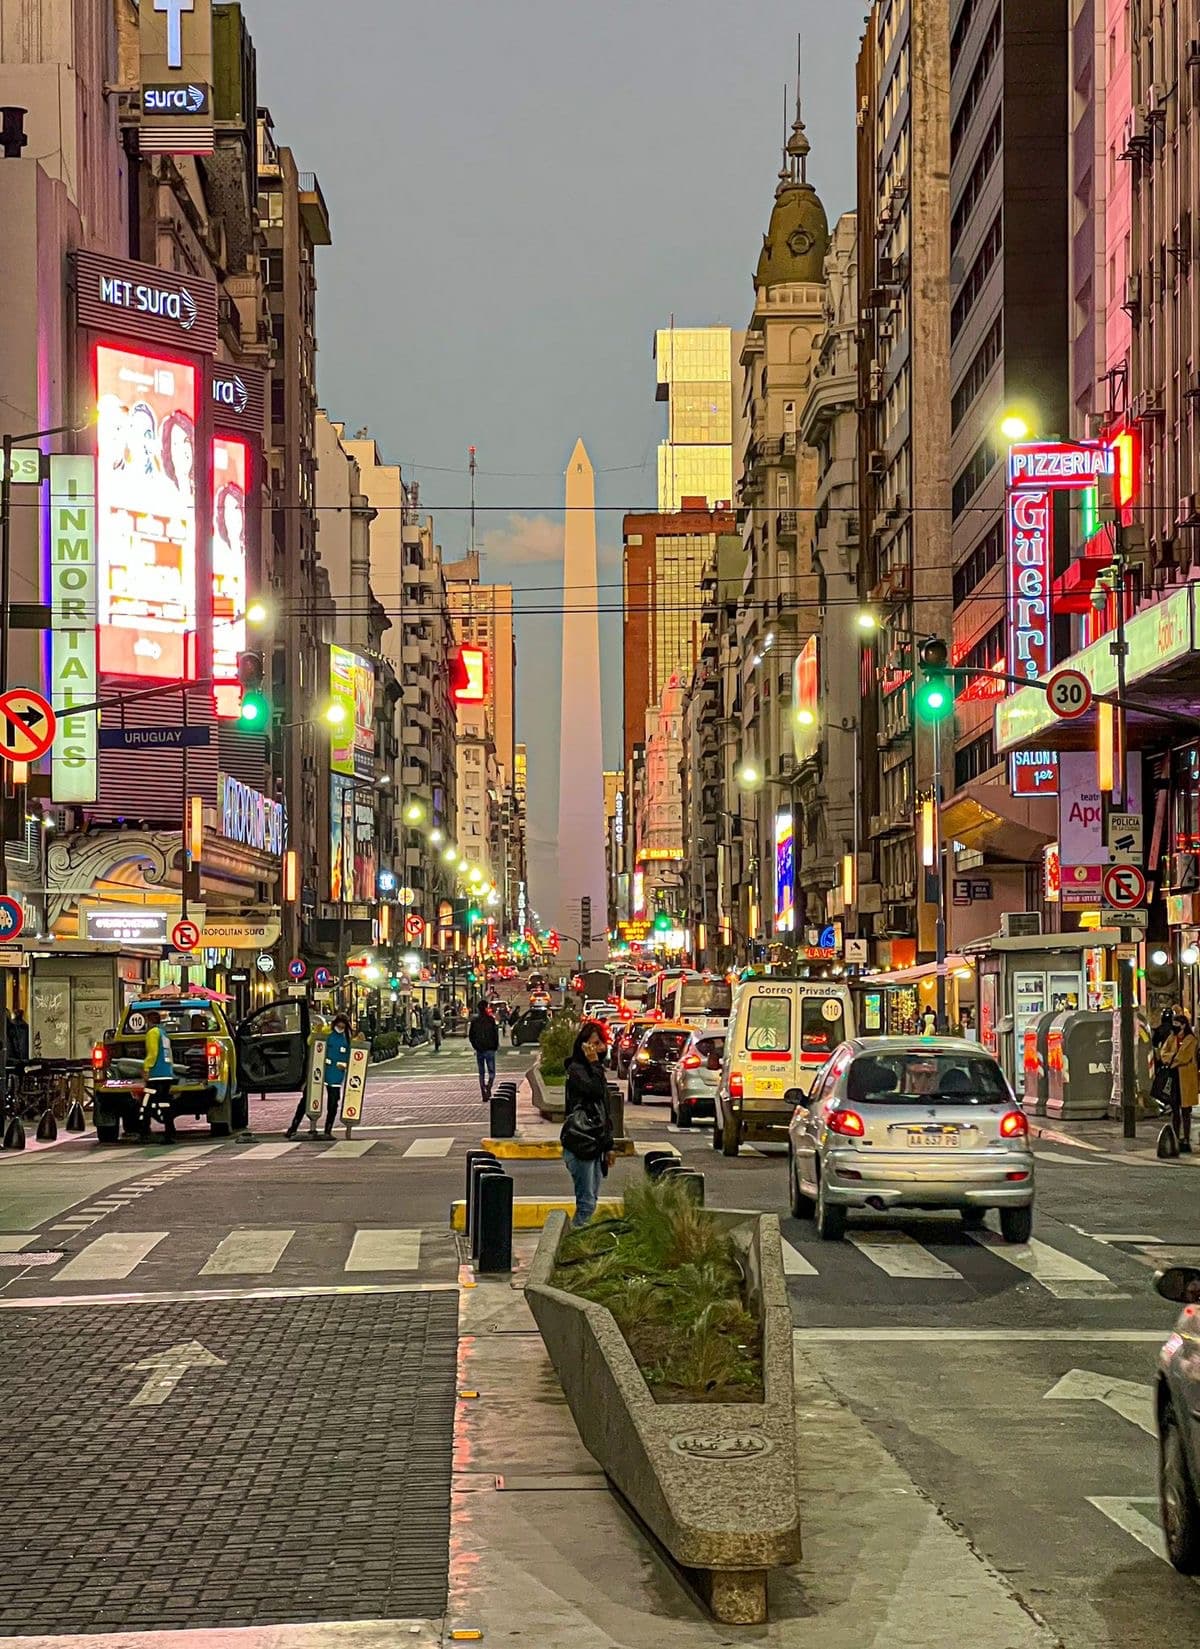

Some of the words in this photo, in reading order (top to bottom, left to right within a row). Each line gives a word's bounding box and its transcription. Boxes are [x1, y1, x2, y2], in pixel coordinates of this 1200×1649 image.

[144, 90, 187, 107] sura
[101, 276, 133, 307] MET
[136, 286, 180, 319] sura
[1013, 452, 1105, 476] PIZZERIA
[58, 479, 87, 768] INMORTALES
[1056, 684, 1082, 704] 30
[124, 731, 182, 743] URUGUAY
[758, 986, 793, 994] Correo
[825, 1004, 839, 1016] 110
